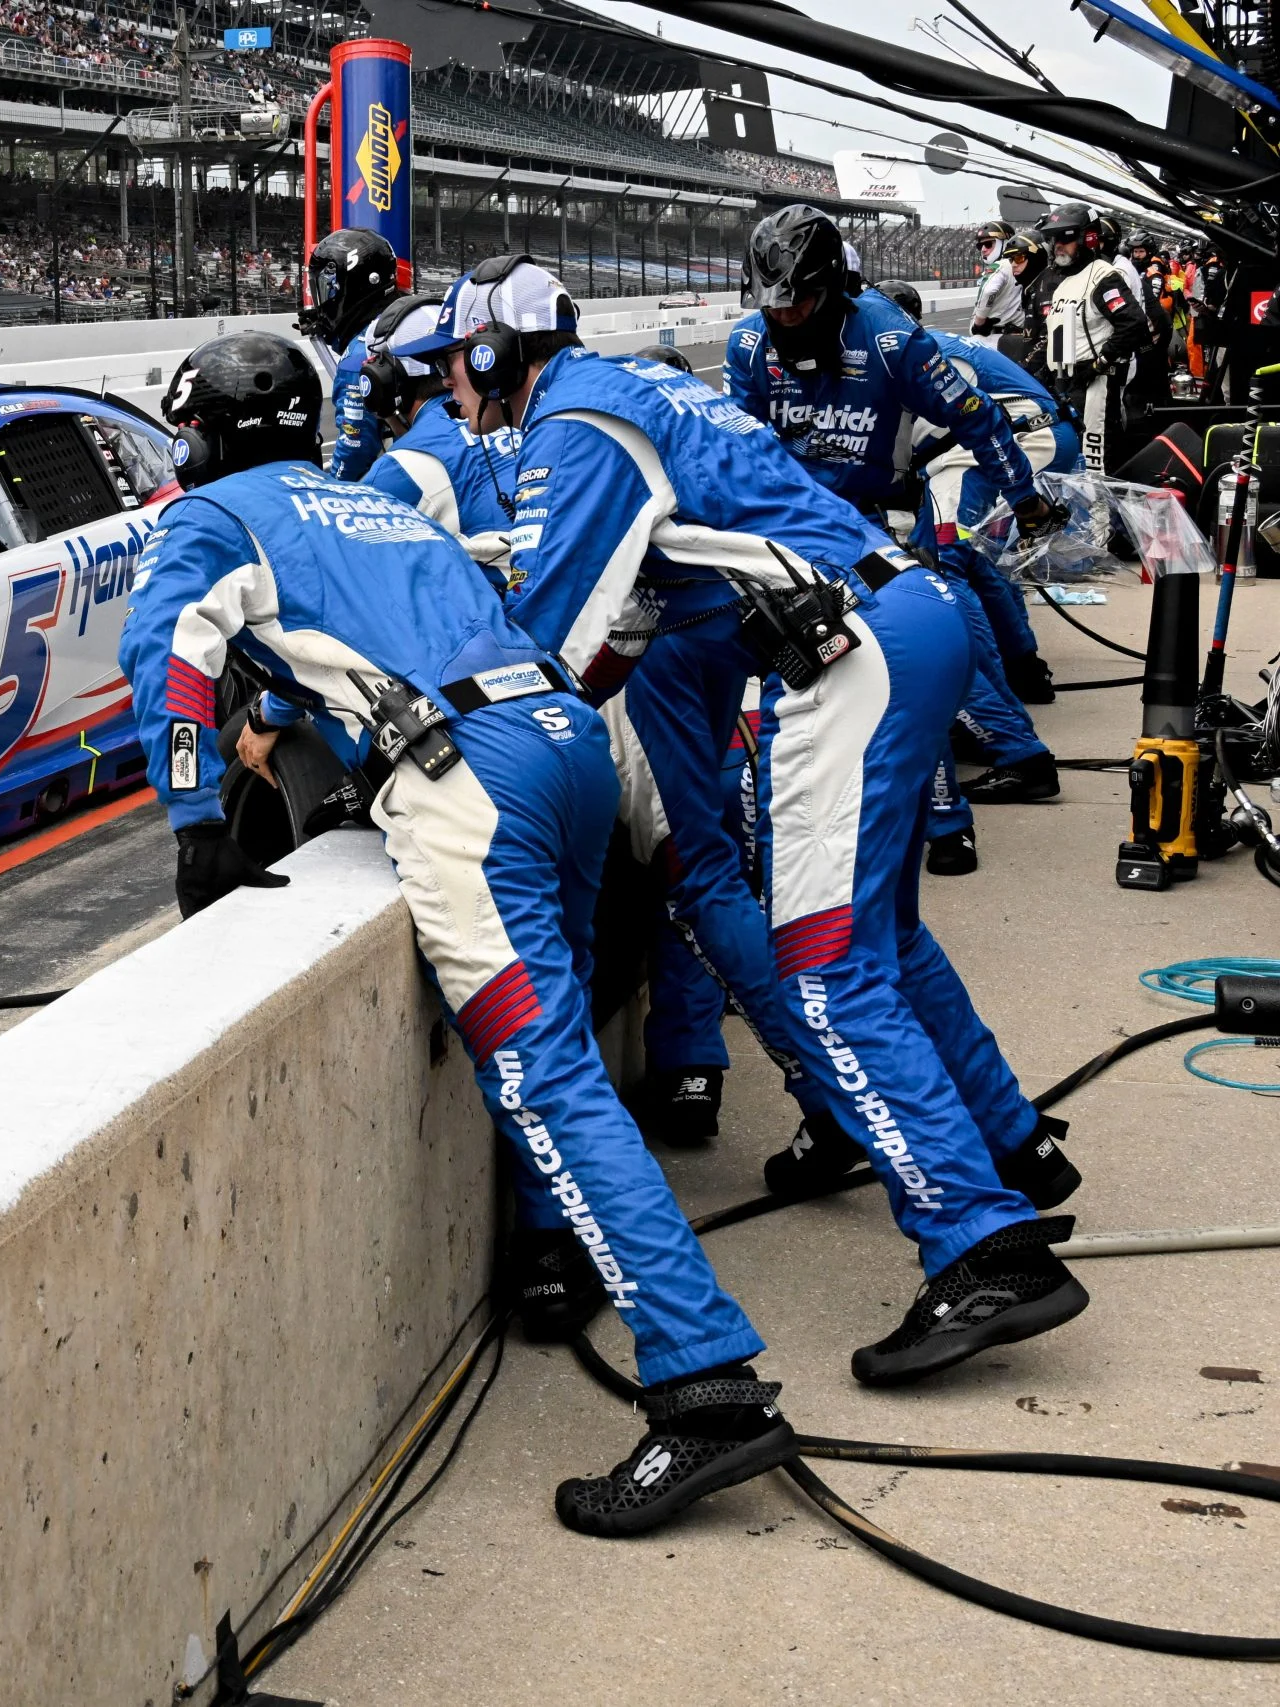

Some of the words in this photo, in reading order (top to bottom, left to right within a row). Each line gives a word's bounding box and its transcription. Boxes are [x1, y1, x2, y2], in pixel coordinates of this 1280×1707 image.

[370, 106, 390, 208] SUNOCO
[346, 248, 359, 271] 5
[439, 307, 453, 324] 5
[474, 346, 492, 371] hp
[171, 367, 200, 411] 5
[237, 417, 262, 429] Caskey
[279, 418, 304, 427] ENERGY
[174, 441, 188, 466] hp
[1085, 431, 1102, 472] OFFI
[956, 709, 996, 744] Hend
[1127, 868, 1142, 879] 5
[1037, 1139, 1055, 1157] OMP
[934, 1302, 950, 1317] OMP
